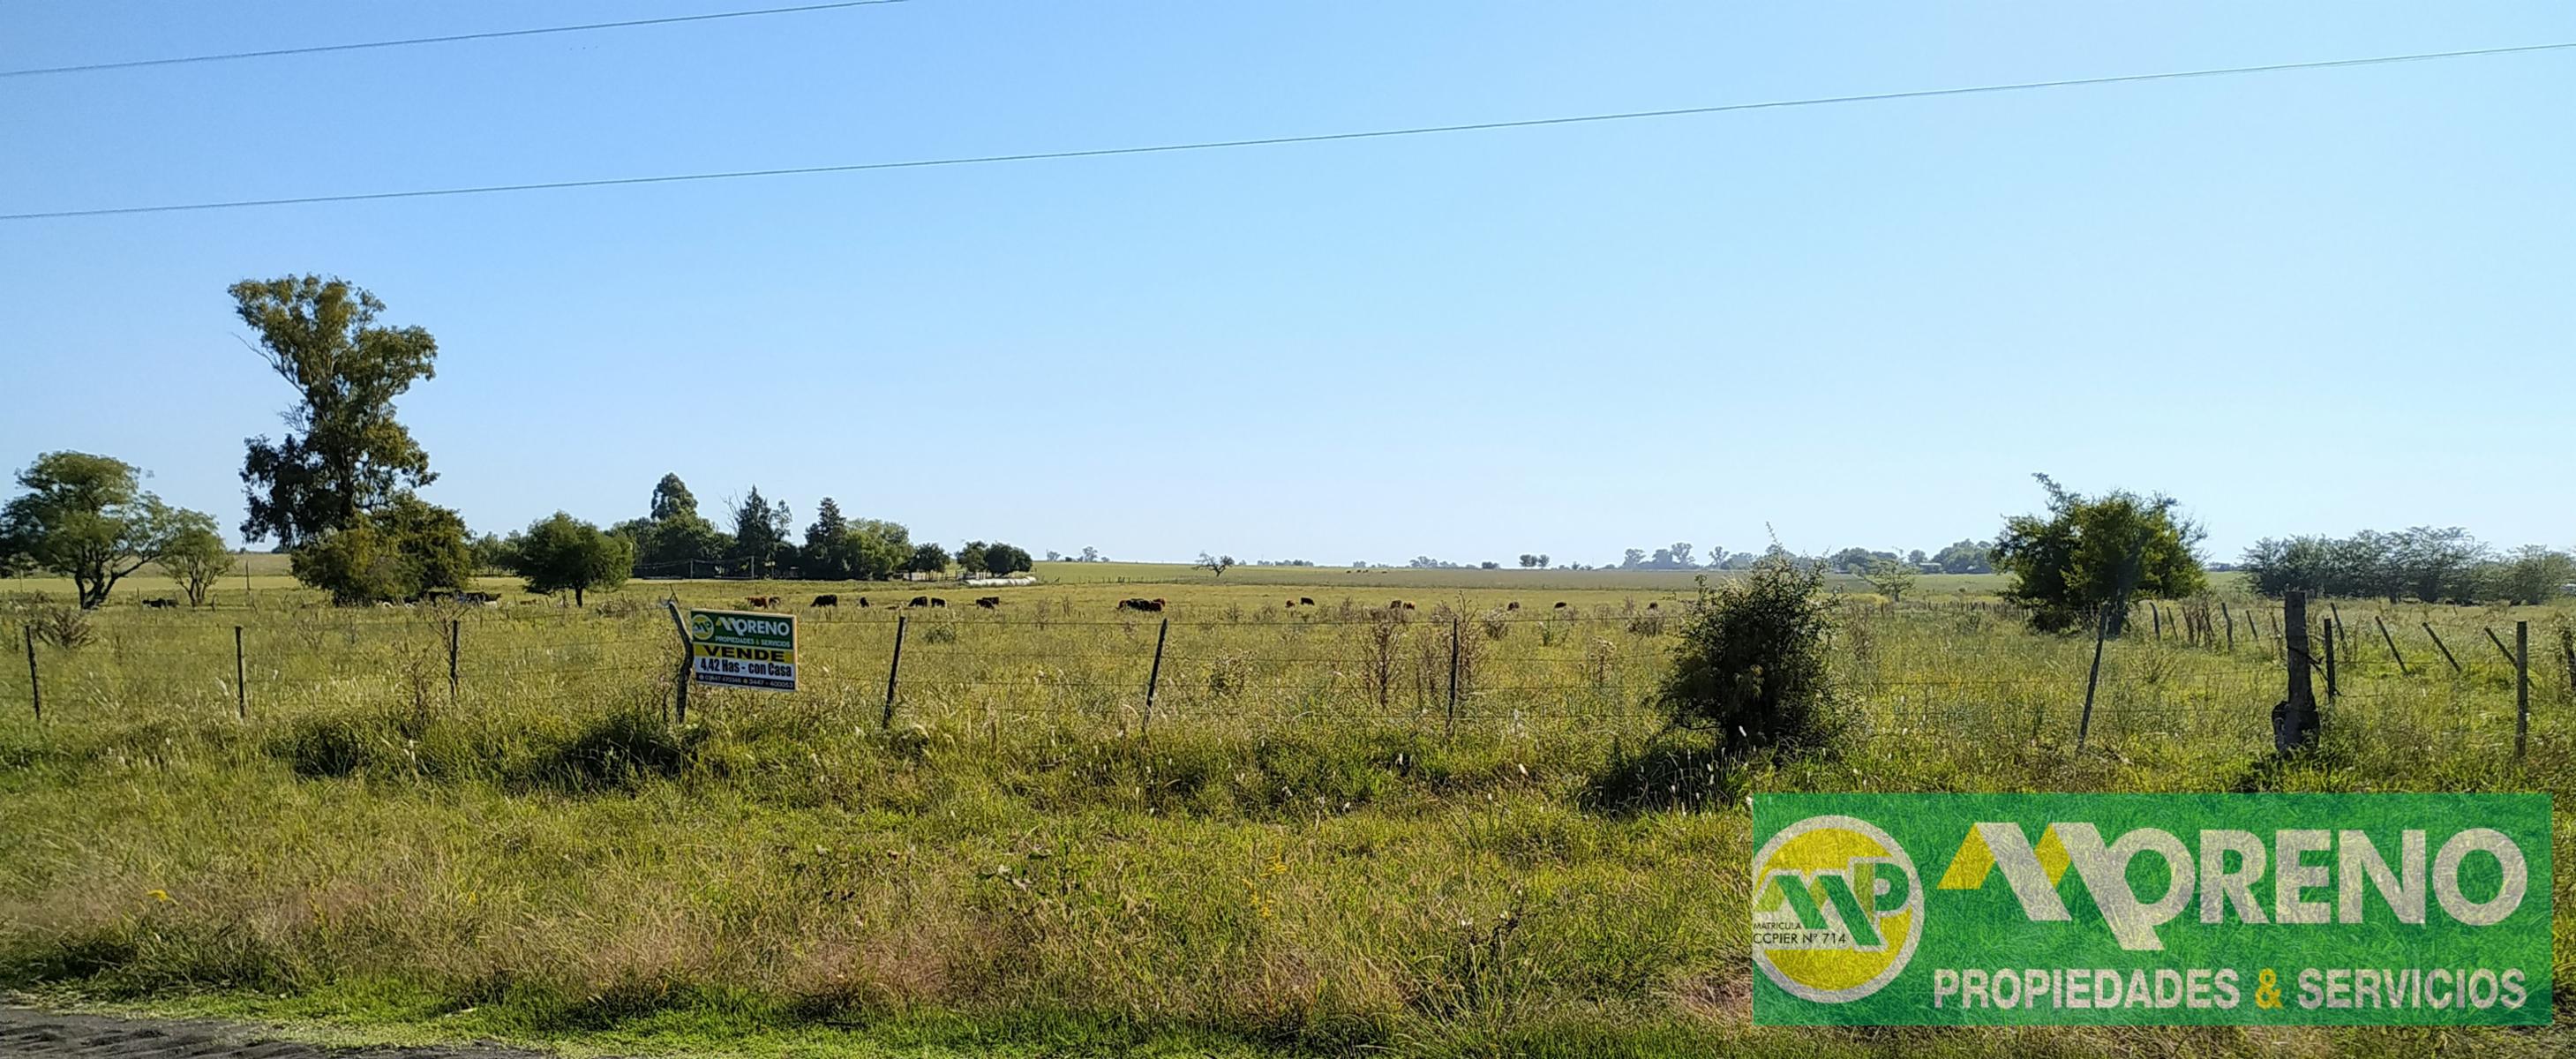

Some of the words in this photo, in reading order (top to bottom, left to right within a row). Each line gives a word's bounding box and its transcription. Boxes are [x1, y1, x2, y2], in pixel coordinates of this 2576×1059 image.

[716, 617, 790, 635] MORENO
[715, 635, 755, 645] PROPIEDADES
[761, 639, 791, 648] SERVICIOS
[703, 645, 785, 662] VENDE
[701, 658, 720, 672] 4,42
[722, 659, 740, 673] Has
[748, 663, 766, 675] con
[768, 663, 792, 677] Casa
